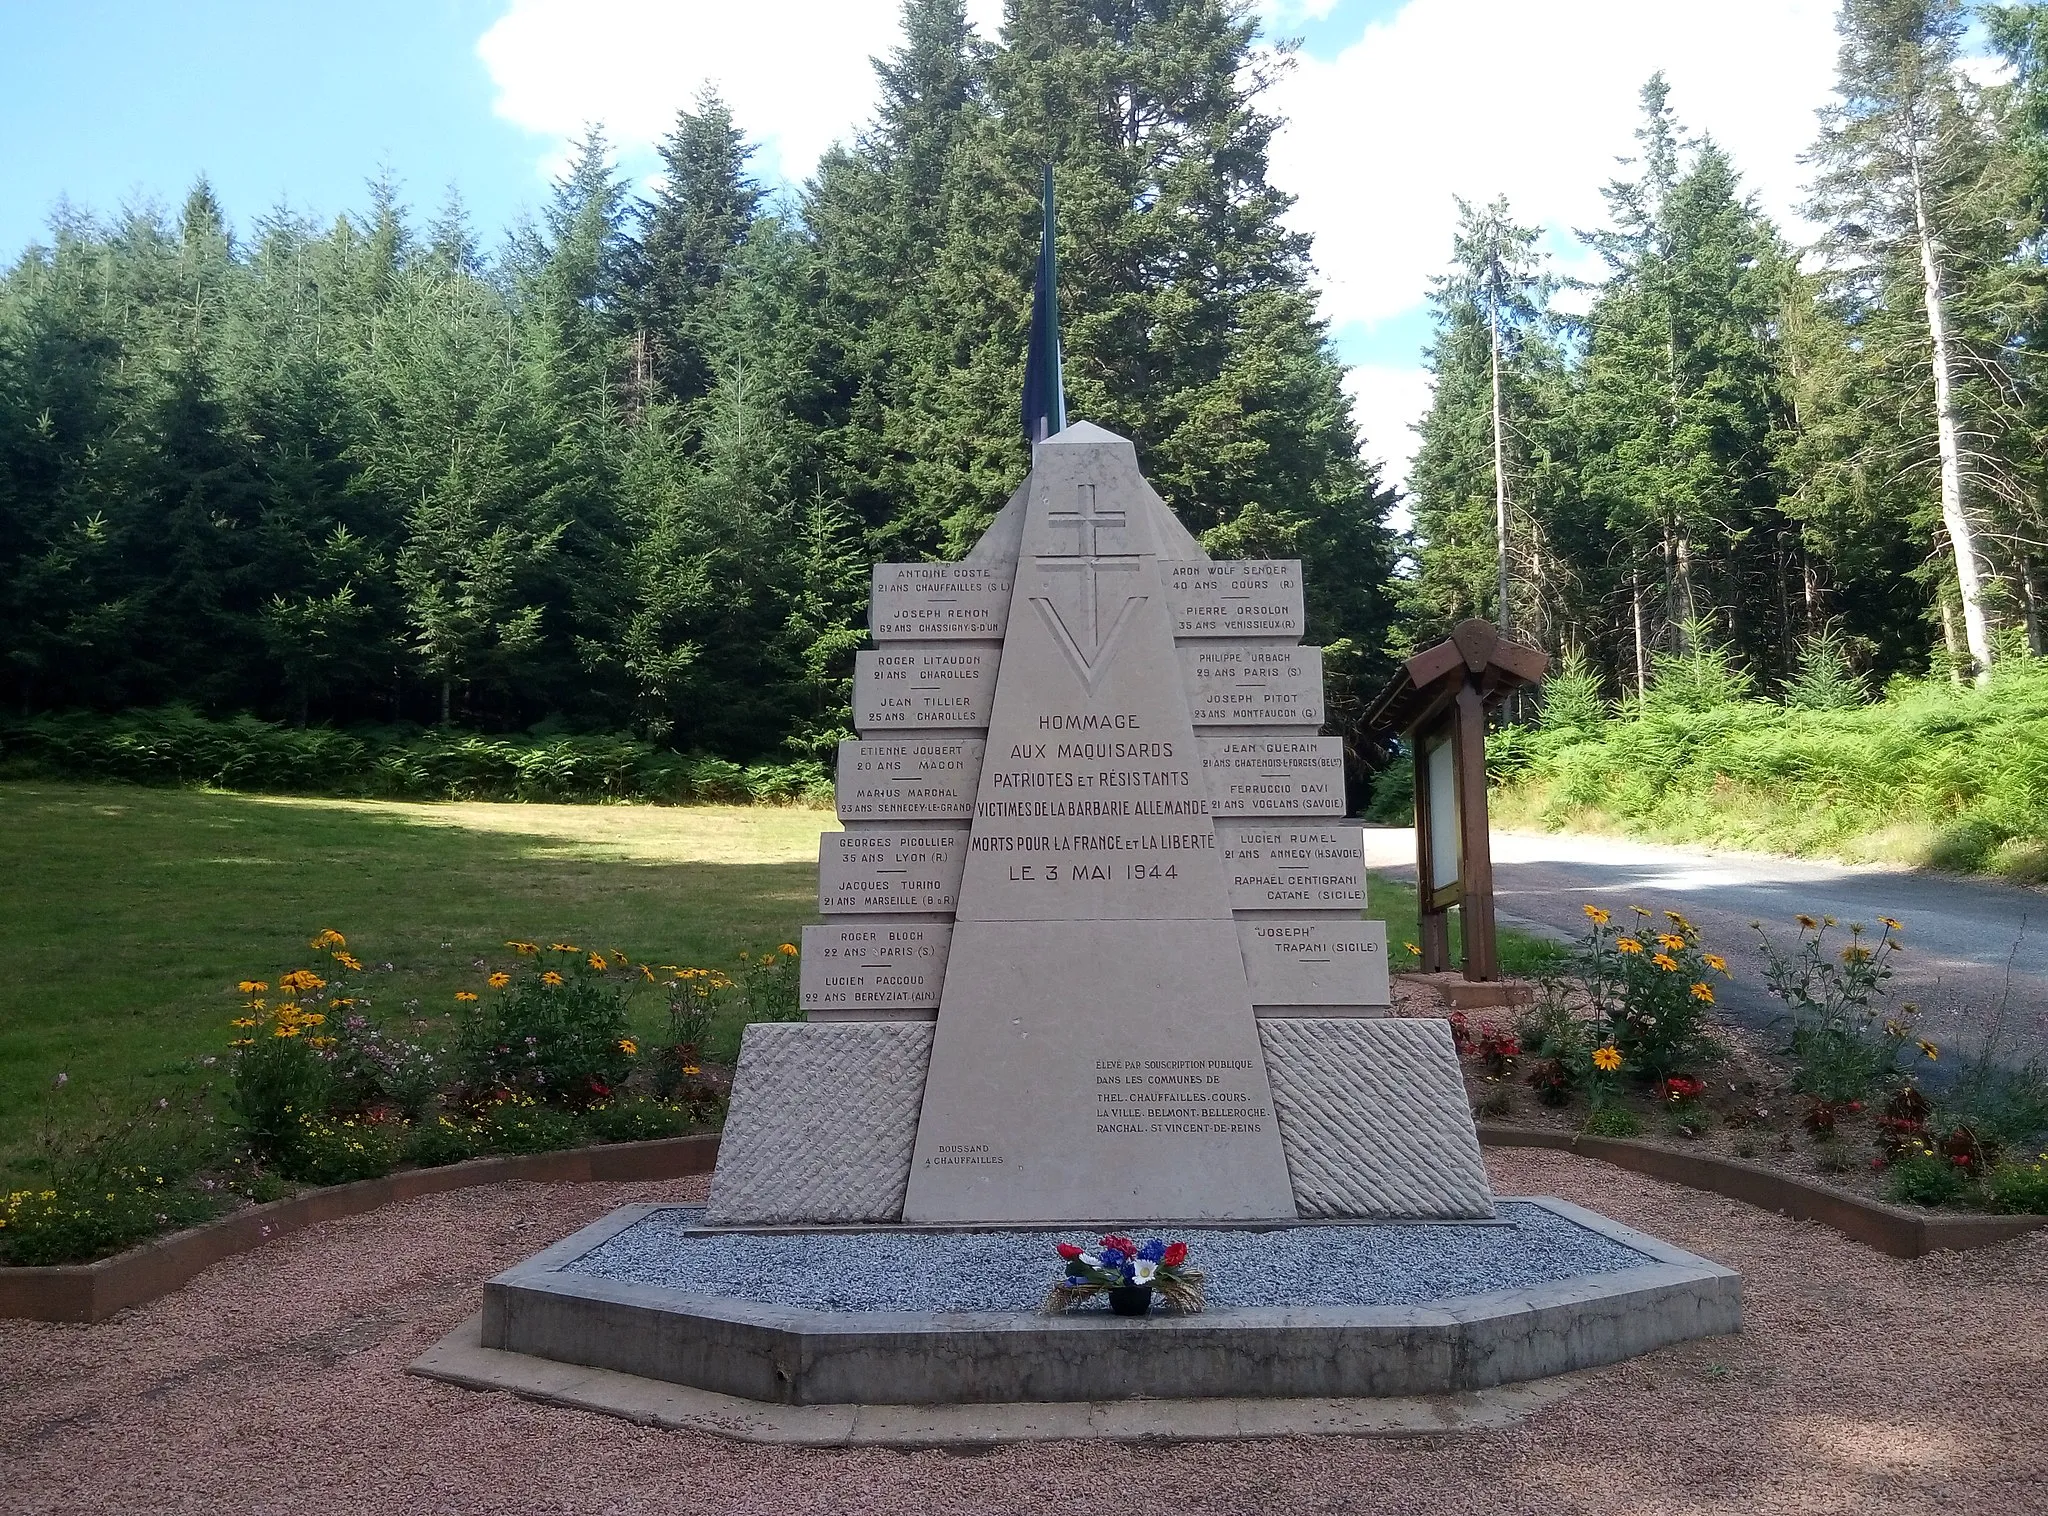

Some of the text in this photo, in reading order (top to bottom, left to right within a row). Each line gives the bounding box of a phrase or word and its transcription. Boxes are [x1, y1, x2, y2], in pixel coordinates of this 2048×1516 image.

[898, 569, 990, 578] ANTOINE COSTE
[1173, 567, 1287, 576] ARON WOLF SENDER
[878, 584, 887, 593] 21
[890, 584, 908, 592] ANS
[916, 583, 982, 591] CHAUFFAILLES
[1195, 581, 1218, 589] ANS
[1231, 581, 1268, 589] COURS
[1280, 580, 1294, 590] (R)
[894, 609, 989, 619] JOSEPH RENON
[1186, 607, 1288, 615] PIERRE ORSOLON
[894, 624, 912, 632] ANS
[1179, 622, 1192, 630] 35
[1224, 620, 1280, 629] VENISSIEUX
[1281, 620, 1296, 629] (R)
[878, 656, 980, 665] ROGER LITAUDON
[1199, 654, 1290, 663] PHILIPPE URBACH
[874, 671, 979, 680] 21 ANS CHAROLLES
[1197, 667, 1302, 677] 29 ANS PARIS (S)
[880, 698, 970, 707] JEAN TILLIER
[1207, 694, 1298, 703] JOSEPH PITOT
[869, 712, 976, 721] 25 ANS CHAROLLES
[1194, 709, 1317, 719] 23 ANS MONTFAUCON (G)
[1039, 714, 1140, 729] HOMMAGE
[861, 746, 962, 756] ETIENNE JOUBERT
[1010, 743, 1172, 760] AUX MAQUISARDS
[1224, 744, 1317, 753] JEAN GUERAIN
[857, 761, 964, 770] 20 ANS MACON
[1203, 759, 1211, 768] 21
[1214, 759, 1230, 767] ANS
[994, 768, 1189, 788] PATRIOTES ET RÉSISTANTS
[857, 789, 958, 798] MARIUS MARCHAL
[1230, 784, 1328, 794] FERRUCCIO DAVI
[841, 805, 852, 813] 23
[855, 804, 872, 812] ANS
[977, 800, 1209, 817] VICTIMES DE LA BARBARIE ALLEMANDE
[1211, 799, 1344, 809] 21 ANS VOGLANS (SAVOIE)
[839, 837, 955, 847] GEORGES PICOLLIER
[972, 831, 1215, 851] MORTS POUR LA FRANCE ET LA LIBERTÉ
[1241, 834, 1336, 843] LUCIEN RUMEL
[842, 854, 856, 862] 35
[862, 854, 884, 862] ANS
[896, 854, 926, 862] LYON
[1225, 850, 1234, 859] 21
[1239, 850, 1260, 859] ANS
[1270, 850, 1311, 858] ANNECY
[1009, 865, 1178, 881] LE 3 MAI 1944
[1288, 876, 1357, 885] CENTIGRANI
[839, 881, 941, 891] JACQUES TURINO
[1267, 890, 1365, 900] CATANE (SICILE)
[824, 898, 833, 906] 21
[837, 897, 856, 906] ANS
[864, 896, 917, 905] MARSEILLE
[841, 932, 923, 941] ROGER BLOCH
[824, 948, 837, 957] 22
[844, 948, 866, 956] ANS
[880, 947, 913, 956] PARIS
[1275, 942, 1378, 953] TRAPANI (SICILE)
[826, 976, 924, 985] LUCIEN PACCOUD
[805, 994, 818, 1002] 22
[825, 993, 846, 1001] ANS
[855, 992, 909, 1001] BEREYZIAT
[1125, 1061, 1141, 1069] PAR
[1145, 1061, 1205, 1069] SOUSCRIPTION
[1208, 1060, 1253, 1070] PUBLIQUE
[1096, 1076, 1220, 1084] DANS LES COMMUNES DE
[1097, 1109, 1109, 1117] LA
[939, 1145, 989, 1153] BOUSSAND
[933, 1156, 1004, 1165] CHAUFFAILLES
